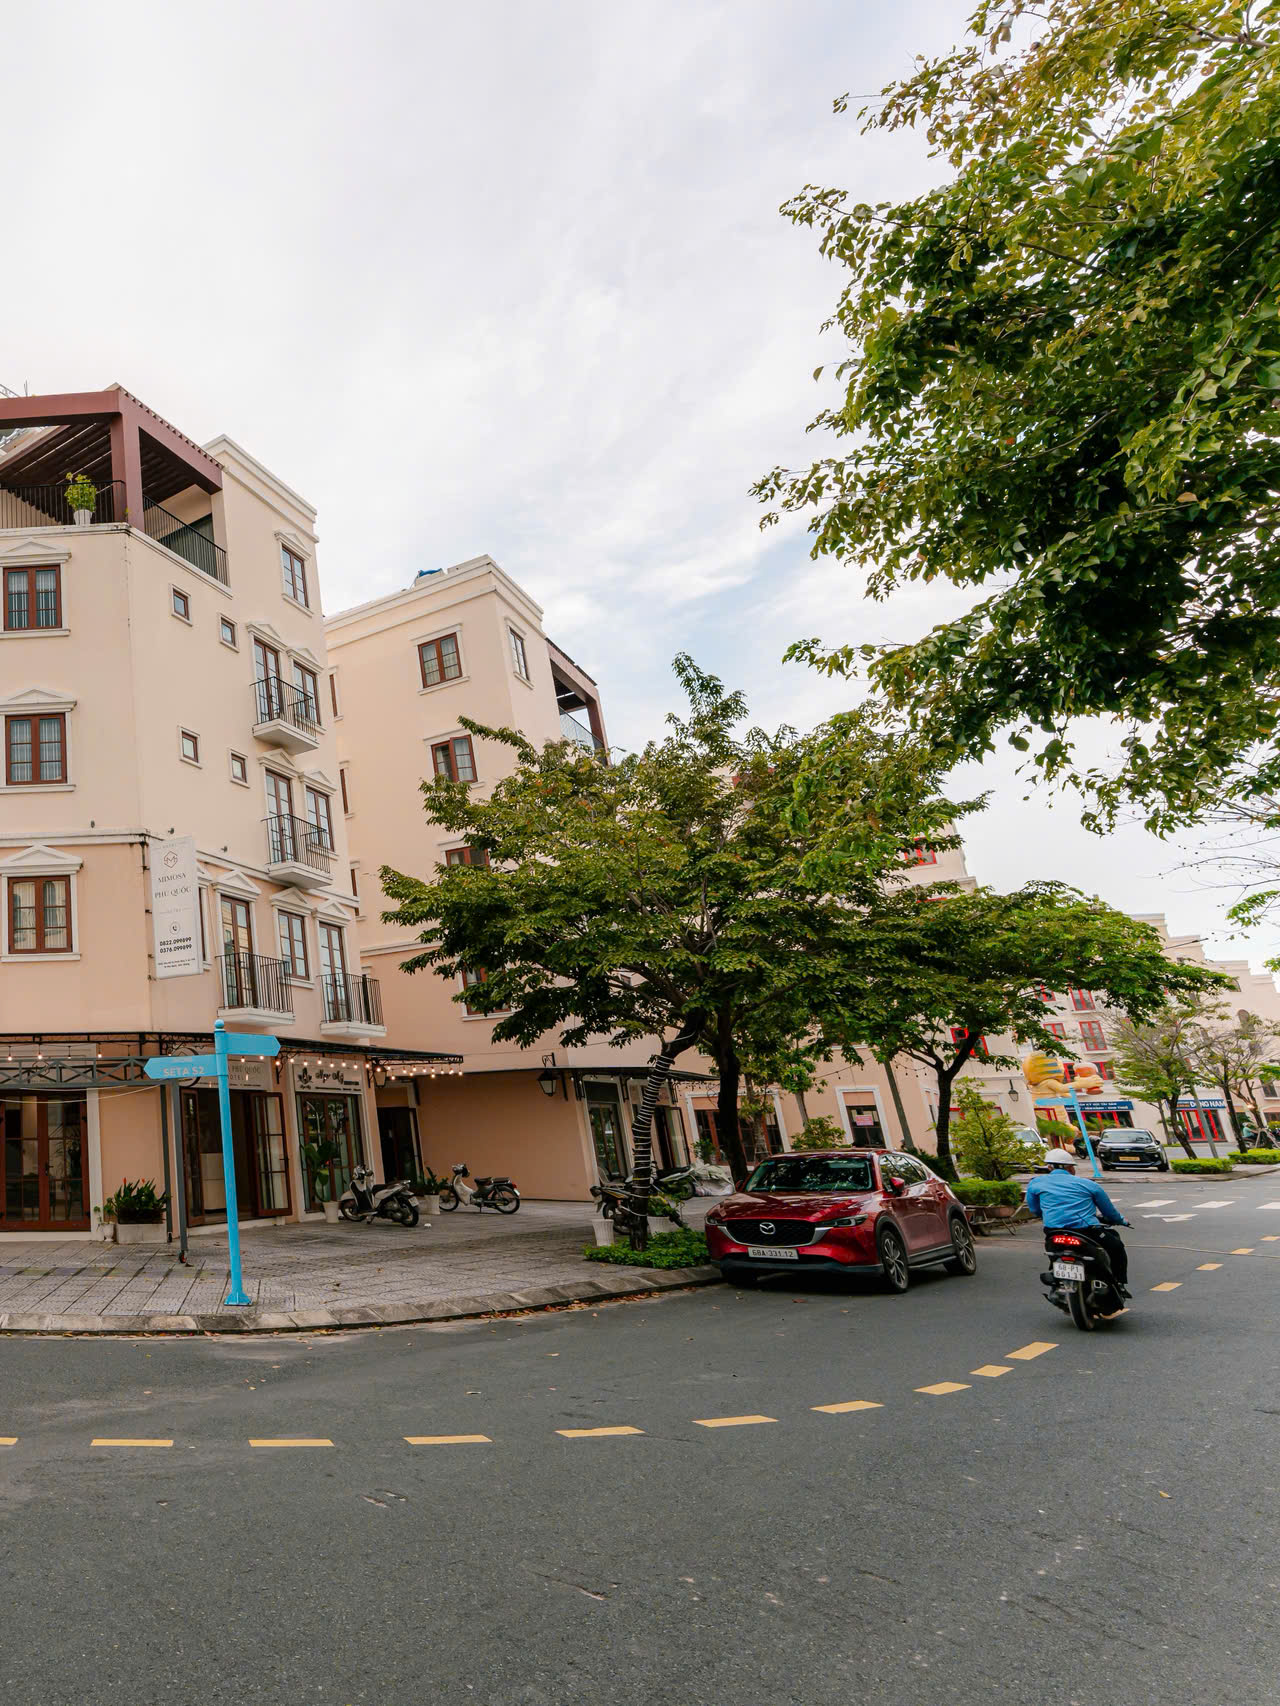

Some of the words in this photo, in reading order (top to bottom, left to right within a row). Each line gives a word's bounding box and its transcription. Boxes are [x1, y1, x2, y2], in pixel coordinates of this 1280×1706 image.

[158, 872, 186, 883] MIMOSA
[163, 1066, 190, 1077] SETA
[192, 1065, 205, 1075] S2
